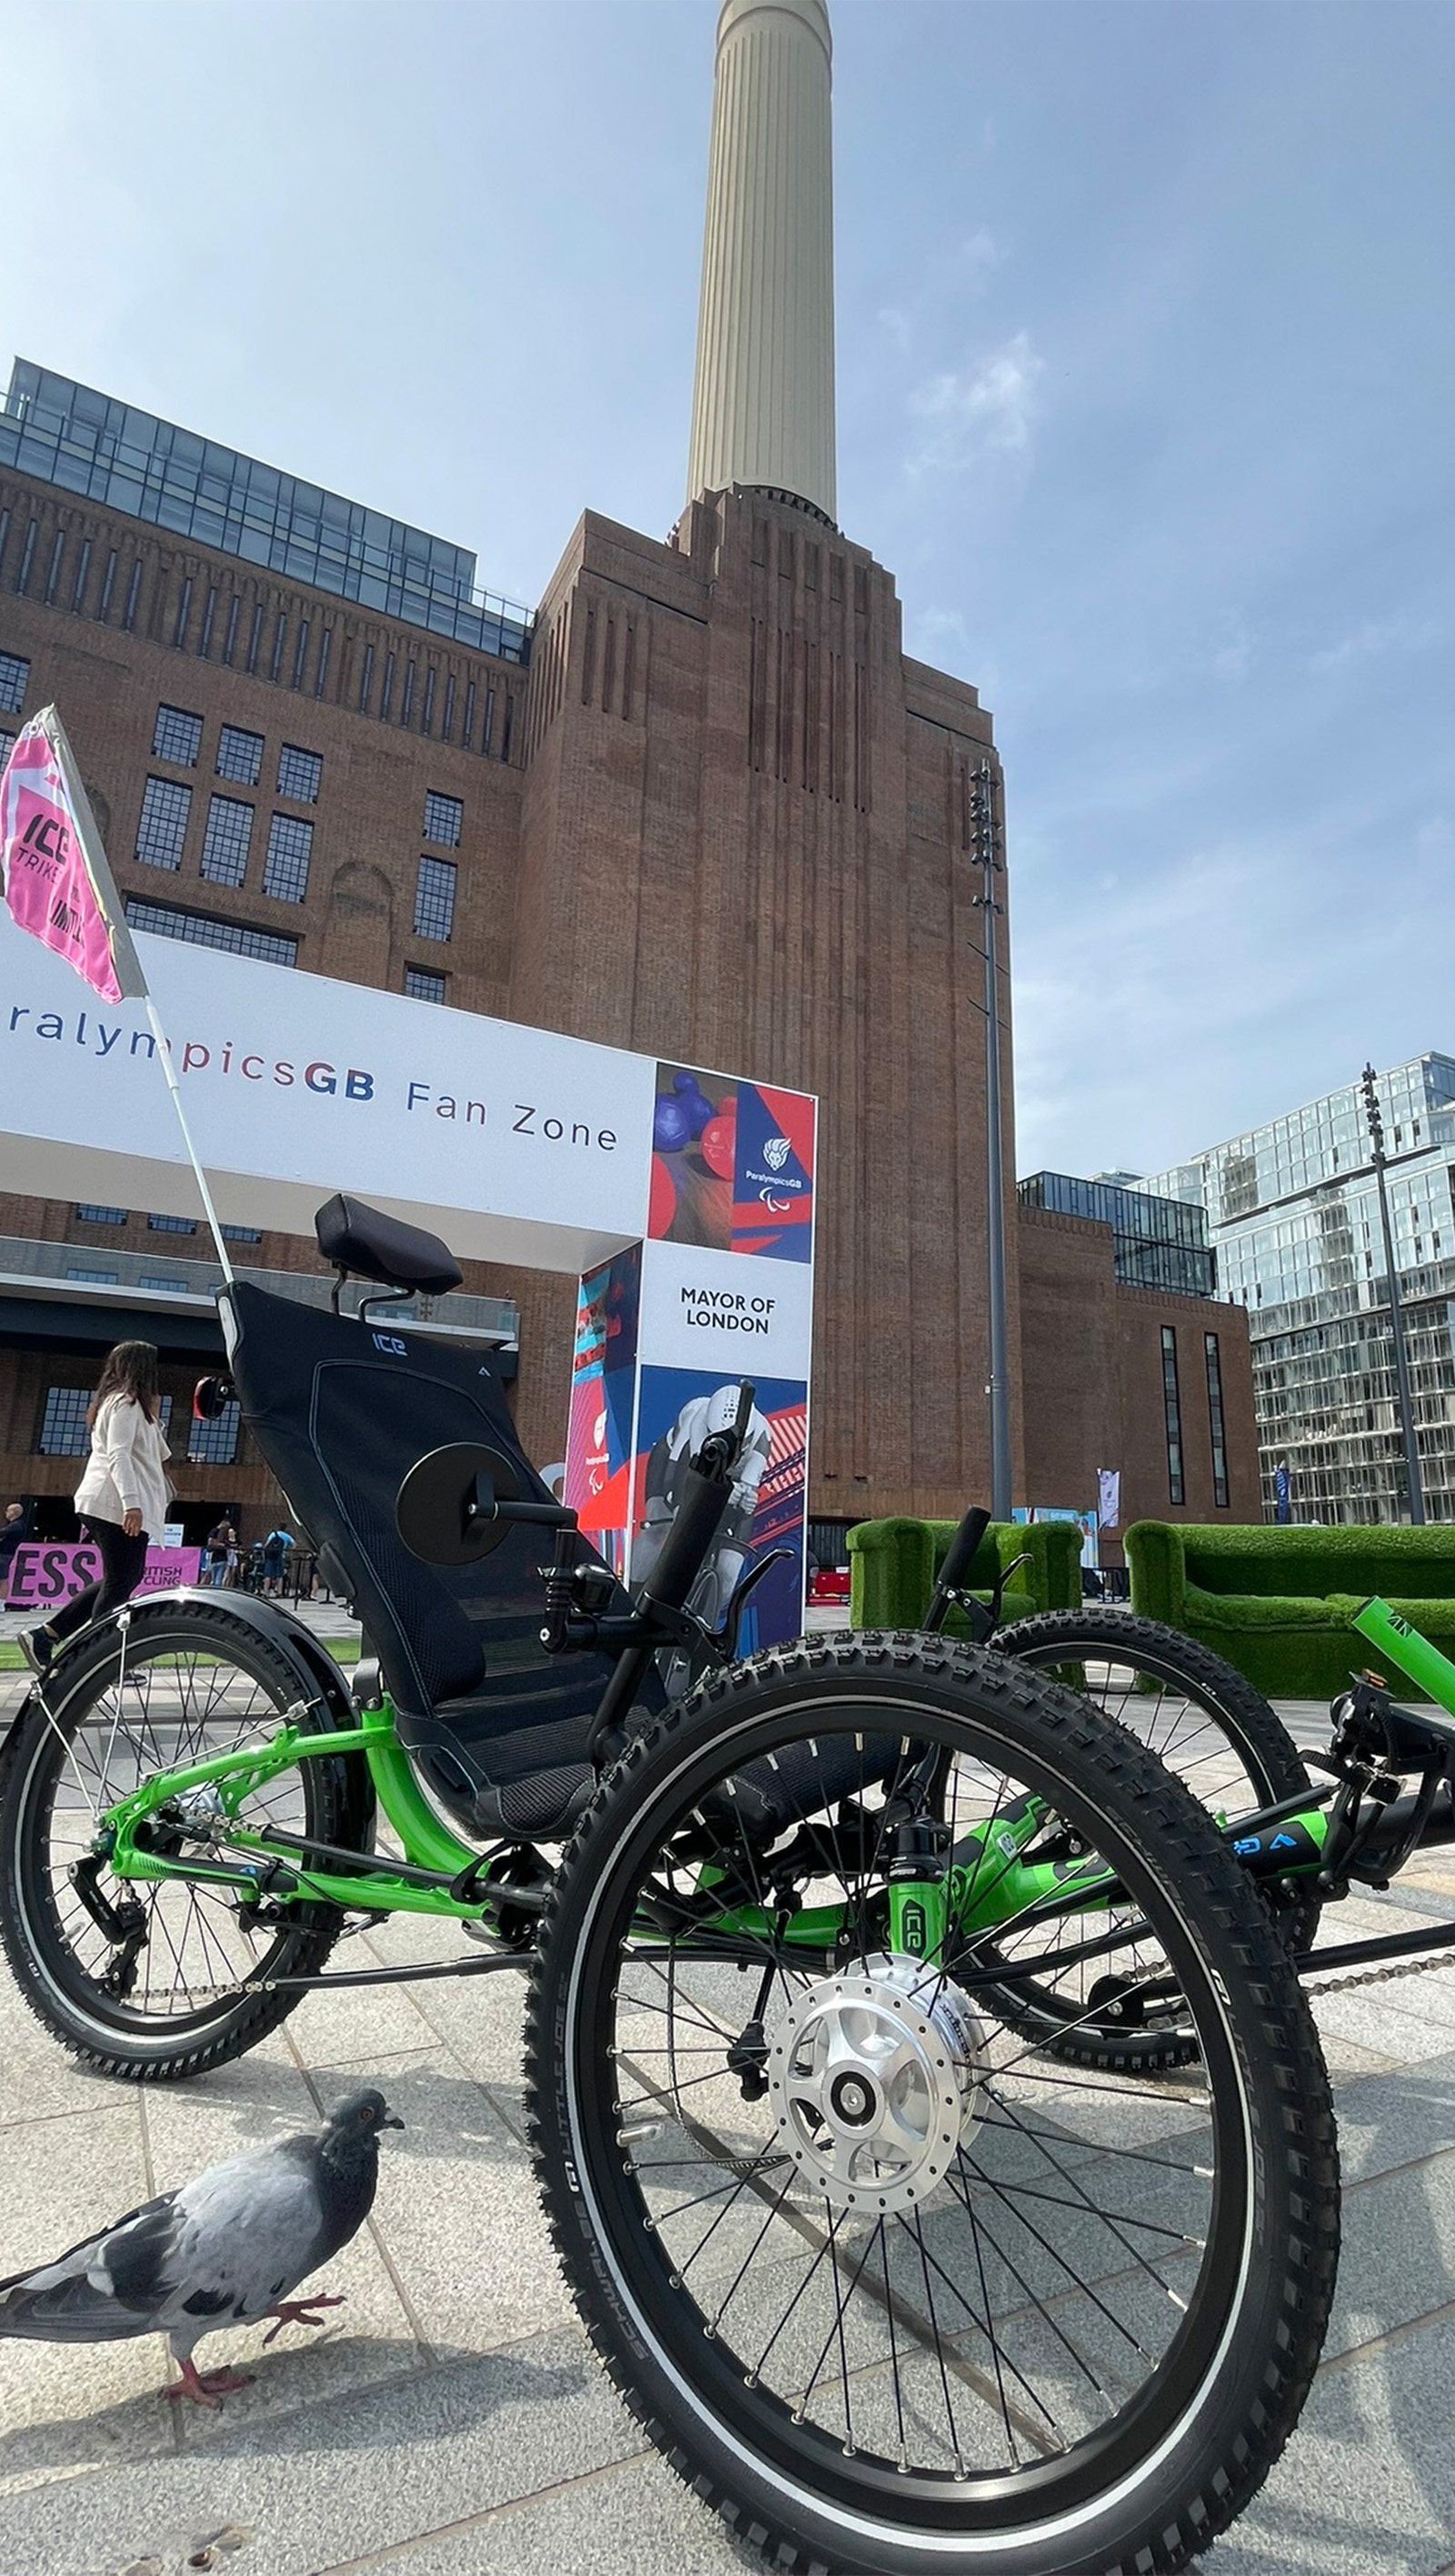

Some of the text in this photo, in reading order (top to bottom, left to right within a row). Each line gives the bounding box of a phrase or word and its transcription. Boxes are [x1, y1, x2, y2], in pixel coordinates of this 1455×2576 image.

[22, 813, 70, 867] ICE
[406, 1082, 487, 1126] Fan
[512, 1104, 618, 1152] Zone
[681, 1287, 776, 1314] MAYOR OF
[686, 1308, 769, 1335] LONDON
[371, 1332, 407, 1357] ICE
[144, 1566, 183, 1577] ITISH
[906, 1909, 922, 1950] ICE
